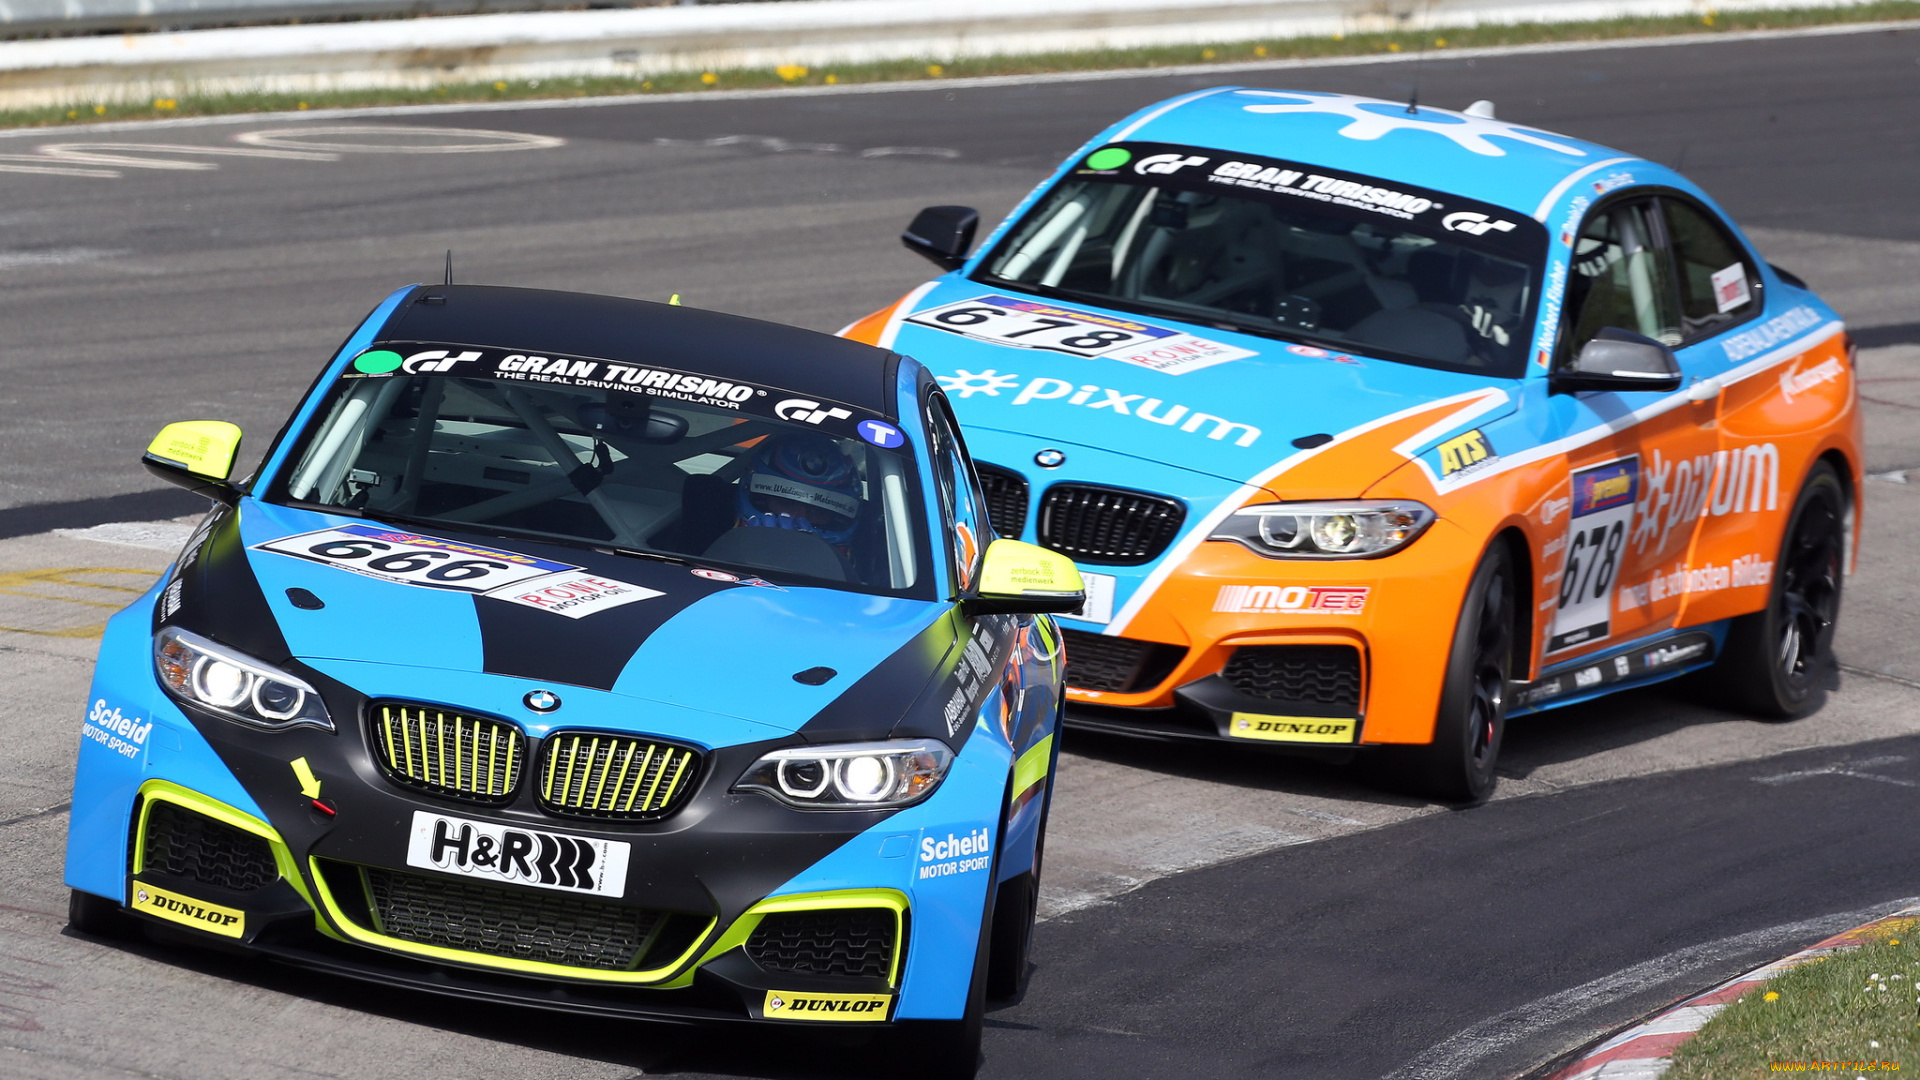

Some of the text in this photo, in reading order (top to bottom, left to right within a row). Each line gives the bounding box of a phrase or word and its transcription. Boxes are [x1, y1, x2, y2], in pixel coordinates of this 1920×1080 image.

[1208, 174, 1414, 220] THE REAL DRIVING SIMULATOR
[1213, 161, 1433, 214] GRAN TURISMO
[935, 307, 1133, 349] 678
[1537, 299, 1562, 351] Norbert
[1131, 340, 1220, 366] ROWE
[493, 371, 740, 410] THE REAL DRIVING SIMULATOR
[498, 354, 753, 402] GRAN TURISMO
[1011, 377, 1262, 448] pixum
[867, 422, 896, 444] T
[1435, 429, 1488, 476] ATS
[1655, 442, 1780, 556] pixum
[308, 539, 509, 582] 666
[1010, 576, 1054, 585] medienwerk
[1558, 520, 1625, 610] 678
[521, 578, 620, 607] ROWE
[549, 587, 632, 612] MOTOR OIL
[82, 722, 141, 759] MOTOR SPORT
[89, 698, 153, 745] Scheid
[1255, 721, 1348, 736] DUNLOP
[431, 819, 538, 882] H&R
[920, 827, 990, 862] Scheid
[919, 855, 990, 880] MOTOR SPORT
[152, 894, 240, 927] DUNLOP
[788, 998, 885, 1013] DUNLOP
